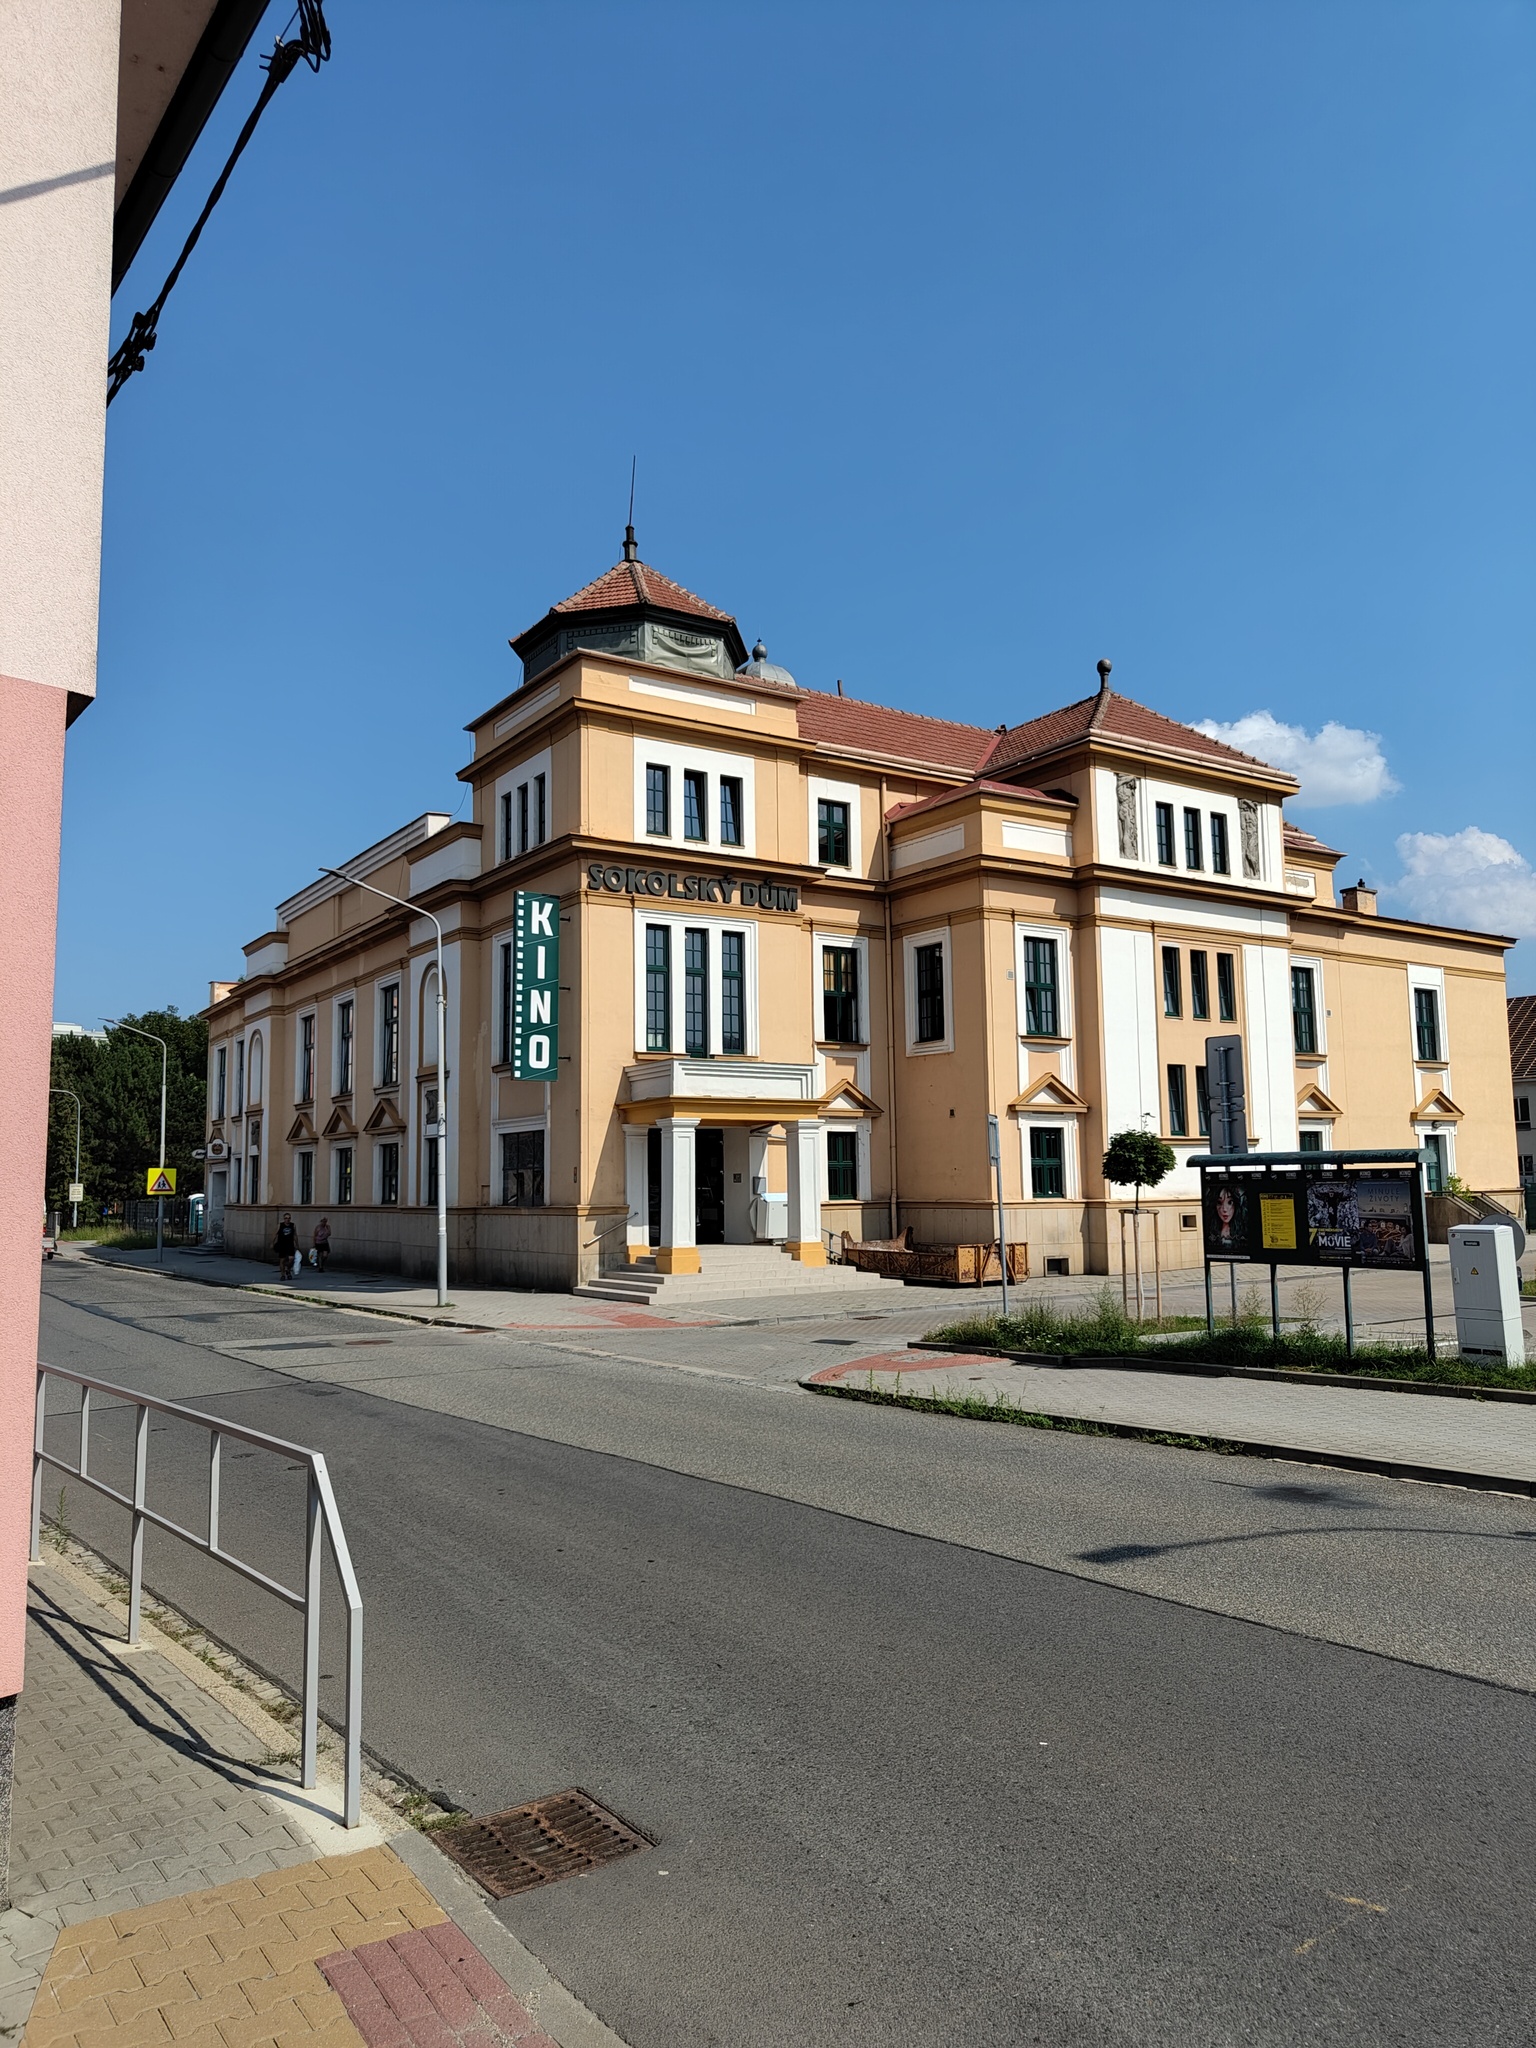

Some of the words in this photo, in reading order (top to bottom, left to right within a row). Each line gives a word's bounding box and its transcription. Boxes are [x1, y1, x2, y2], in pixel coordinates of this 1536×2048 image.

[588, 864, 737, 904] SOKOLSKÝ
[741, 878, 798, 912] DŮM
[528, 900, 554, 1069] KINO
[1367, 1187, 1401, 1195] MINULÉ
[1369, 1194, 1400, 1202] ŽIVOTY
[1308, 1228, 1318, 1246] 7
[1318, 1235, 1352, 1247] MOVIE
